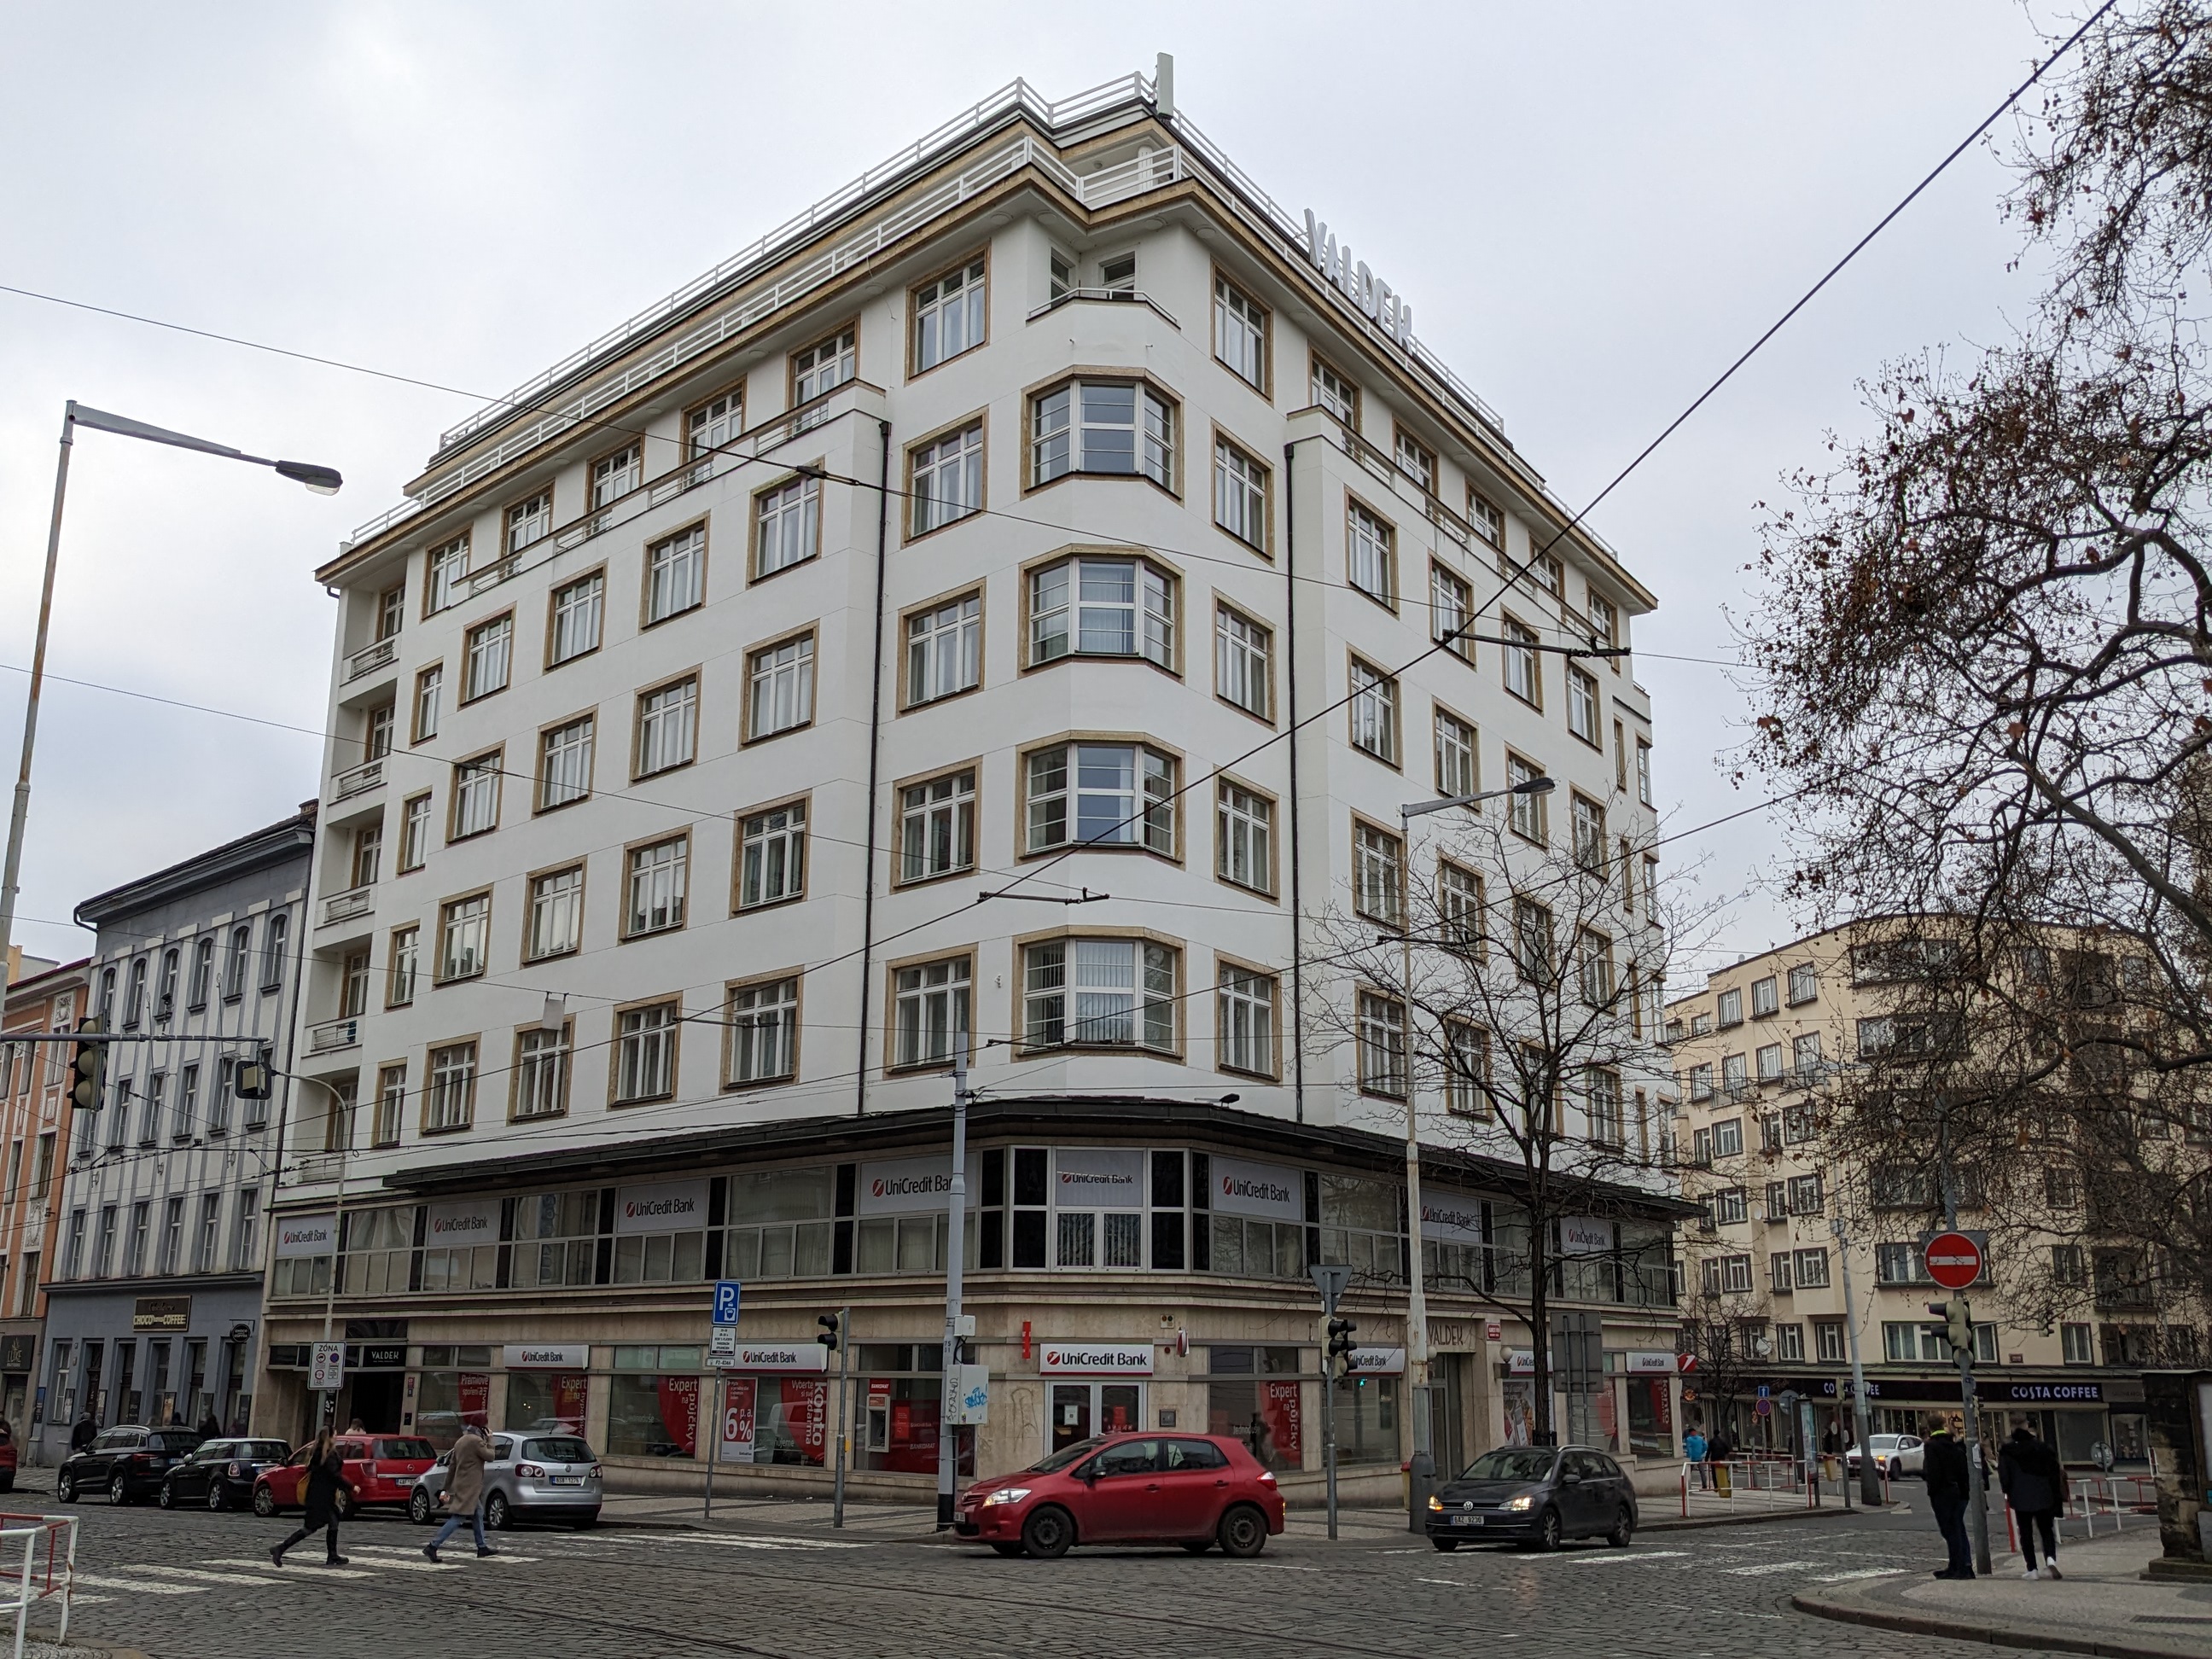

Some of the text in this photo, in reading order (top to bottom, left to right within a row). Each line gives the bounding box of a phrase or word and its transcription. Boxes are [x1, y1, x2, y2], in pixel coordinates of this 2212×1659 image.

[1304, 208, 1412, 356] VALDEK
[885, 1174, 953, 1196] UniCredit Ban
[1073, 1173, 1133, 1184] UniCredit Bank
[1233, 1179, 1289, 1202] UniCredit Bank
[636, 1197, 694, 1216] UniCredit Bank
[442, 1216, 487, 1231] UniCredit Bank
[290, 1229, 328, 1243] UniCredit Bank
[719, 1286, 735, 1311] P
[134, 1314, 154, 1325] CHOCO
[1427, 1324, 1464, 1346] VALDEK
[318, 1343, 339, 1352] ZÓNA
[371, 1351, 399, 1359] VALDEK
[527, 1352, 563, 1362] UniCredit Bank
[751, 1352, 797, 1363] UniCredit Bank
[1062, 1353, 1147, 1365] UniCredit Bank
[562, 1377, 587, 1391] Expert
[669, 1378, 698, 1394] Expert
[792, 1380, 814, 1390] Vyberte
[1270, 1382, 1297, 1401] Expert
[2011, 1386, 2098, 1400] COSTA COFFEE
[812, 1382, 827, 1446] konto
